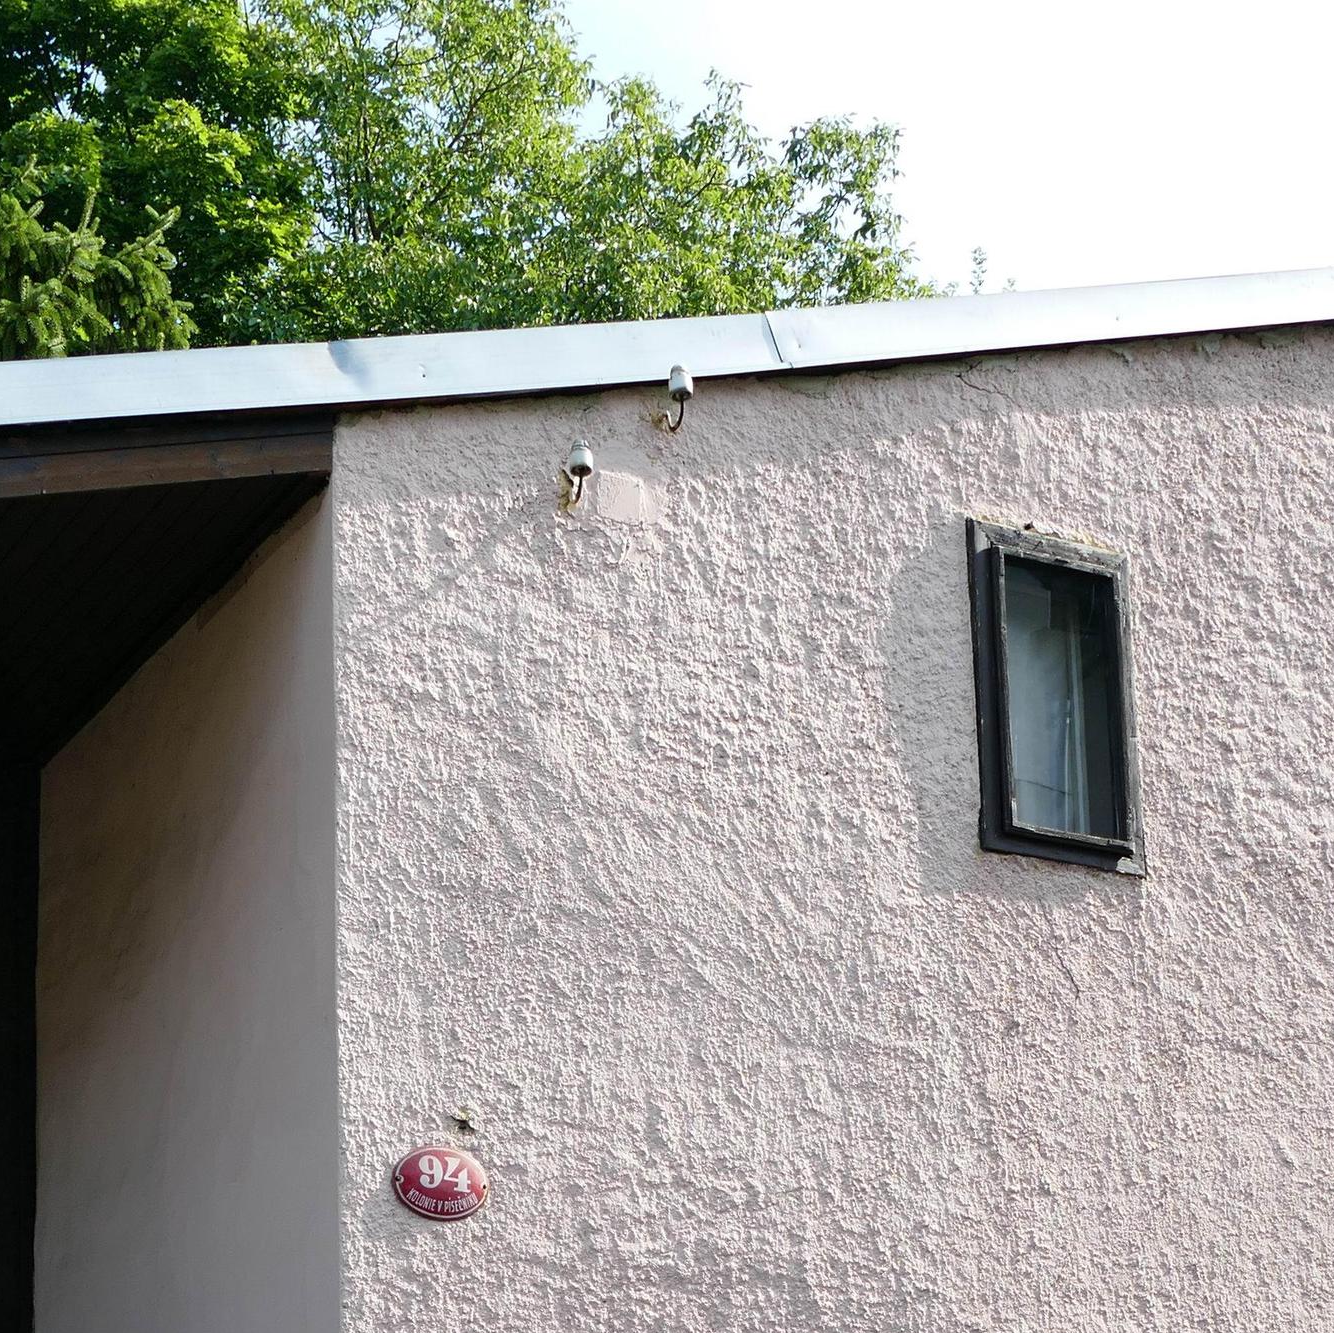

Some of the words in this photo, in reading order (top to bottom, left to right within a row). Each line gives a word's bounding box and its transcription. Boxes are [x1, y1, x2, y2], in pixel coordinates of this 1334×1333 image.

[418, 1154, 471, 1193] 94
[406, 1187, 437, 1212] KOLONIE
[437, 1200, 444, 1213] V
